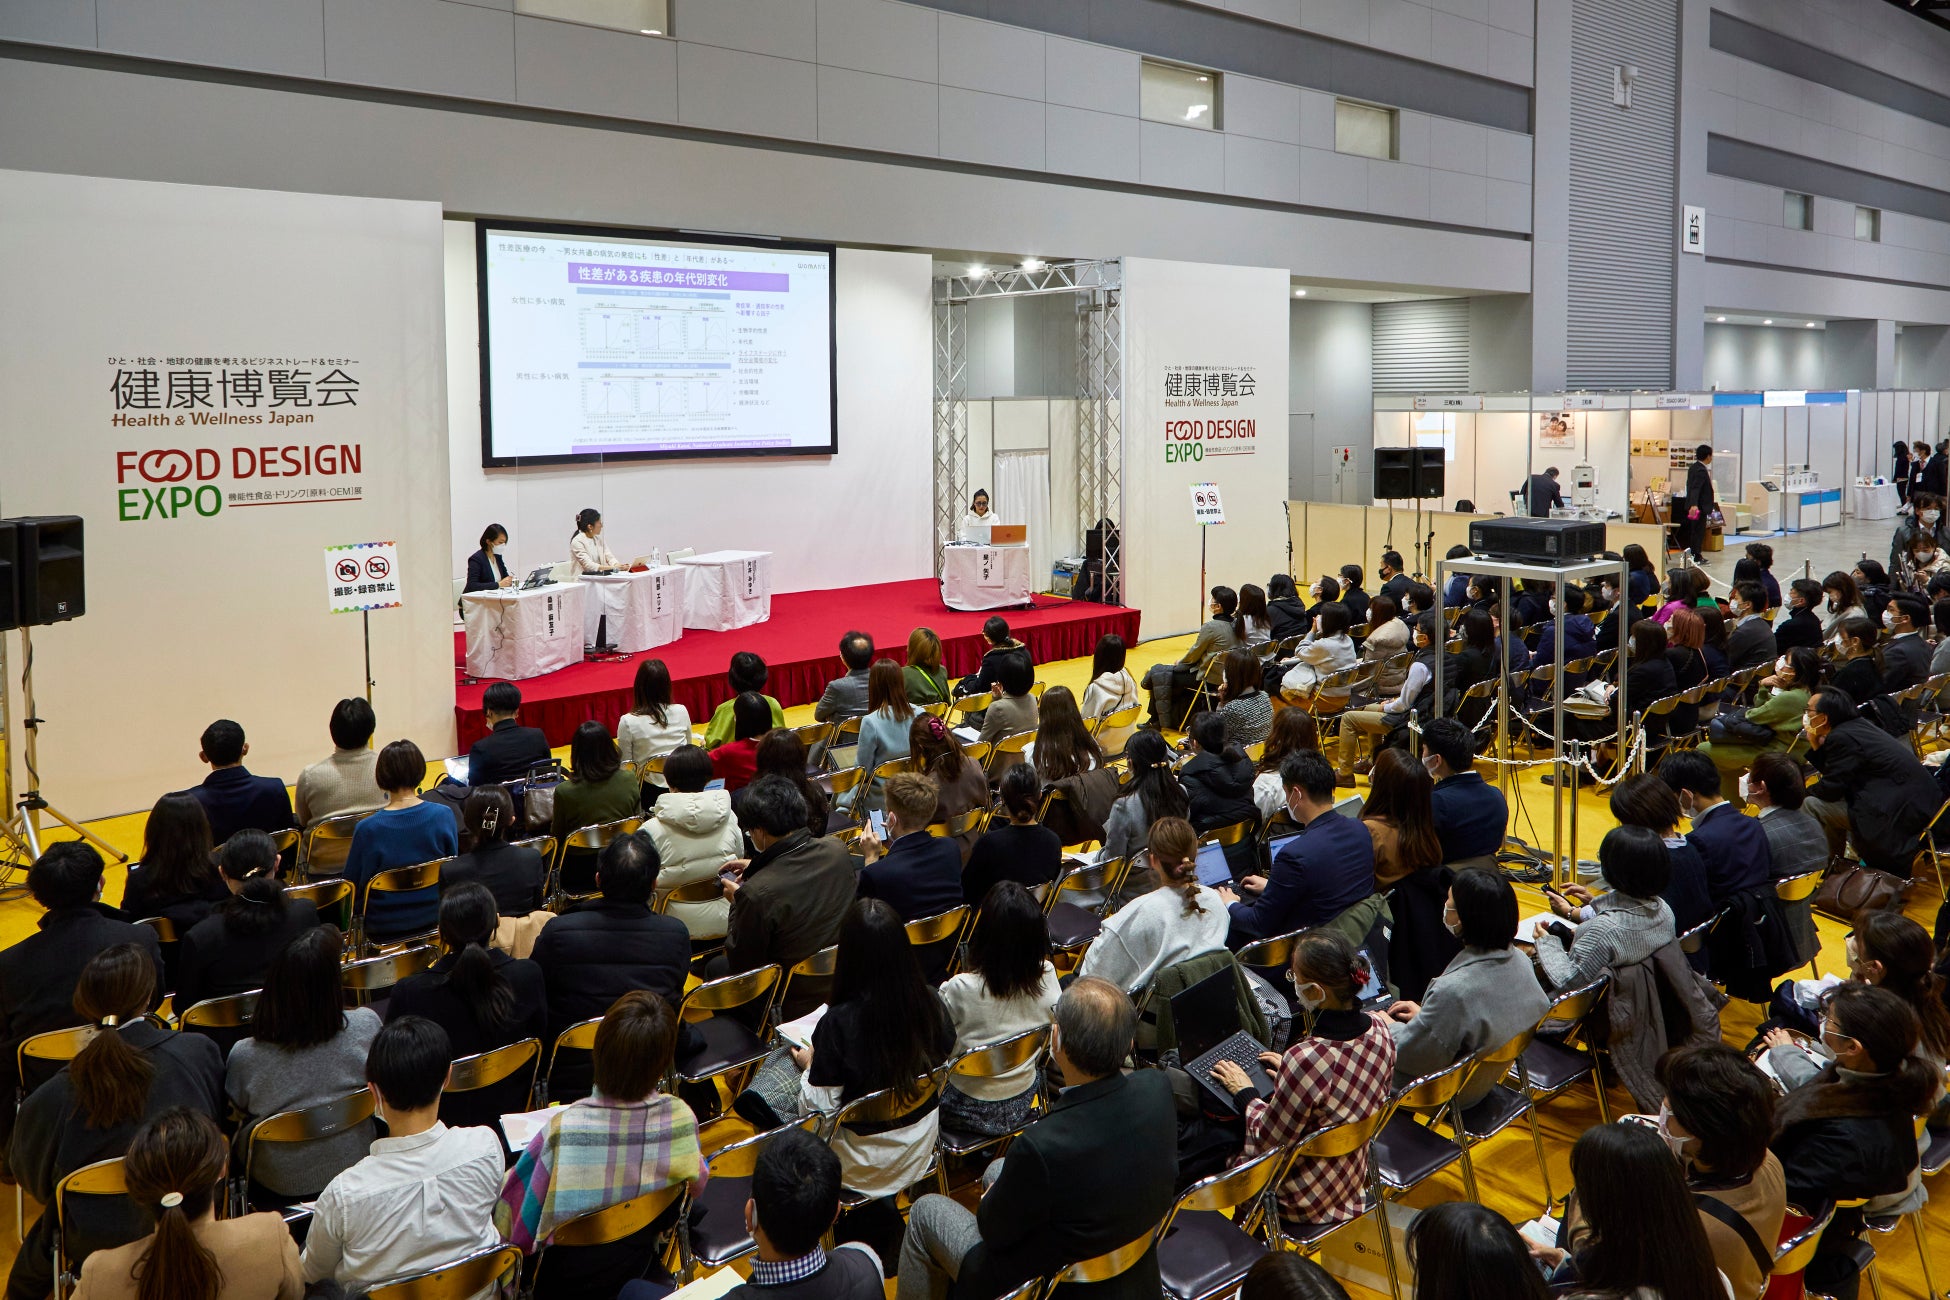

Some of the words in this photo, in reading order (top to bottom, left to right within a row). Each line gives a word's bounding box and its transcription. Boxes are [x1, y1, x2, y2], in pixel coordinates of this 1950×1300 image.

[578, 266, 729, 287] 性差がある疾患の年代別変化
[512, 297, 566, 306] 女性に多い病気
[516, 372, 570, 381] 男性に多い病気
[1164, 372, 1256, 397] 健康博覧会
[109, 368, 360, 410] 健康博覧会
[1165, 399, 1186, 407] Health
[1193, 399, 1220, 407] Wellness
[1220, 398, 1239, 408] Japan
[111, 413, 170, 427] Health
[174, 414, 186, 426] &
[189, 411, 263, 426] Wellness
[268, 410, 314, 427] Japan
[1166, 420, 1203, 441] FOOD
[1207, 419, 1256, 440] DESIGN
[1166, 442, 1203, 463] EXPO
[116, 447, 221, 484] FOOD
[232, 444, 362, 479] DESIGN
[118, 484, 222, 521] EXPO
[333, 582, 396, 598] 撮影・録音禁止
